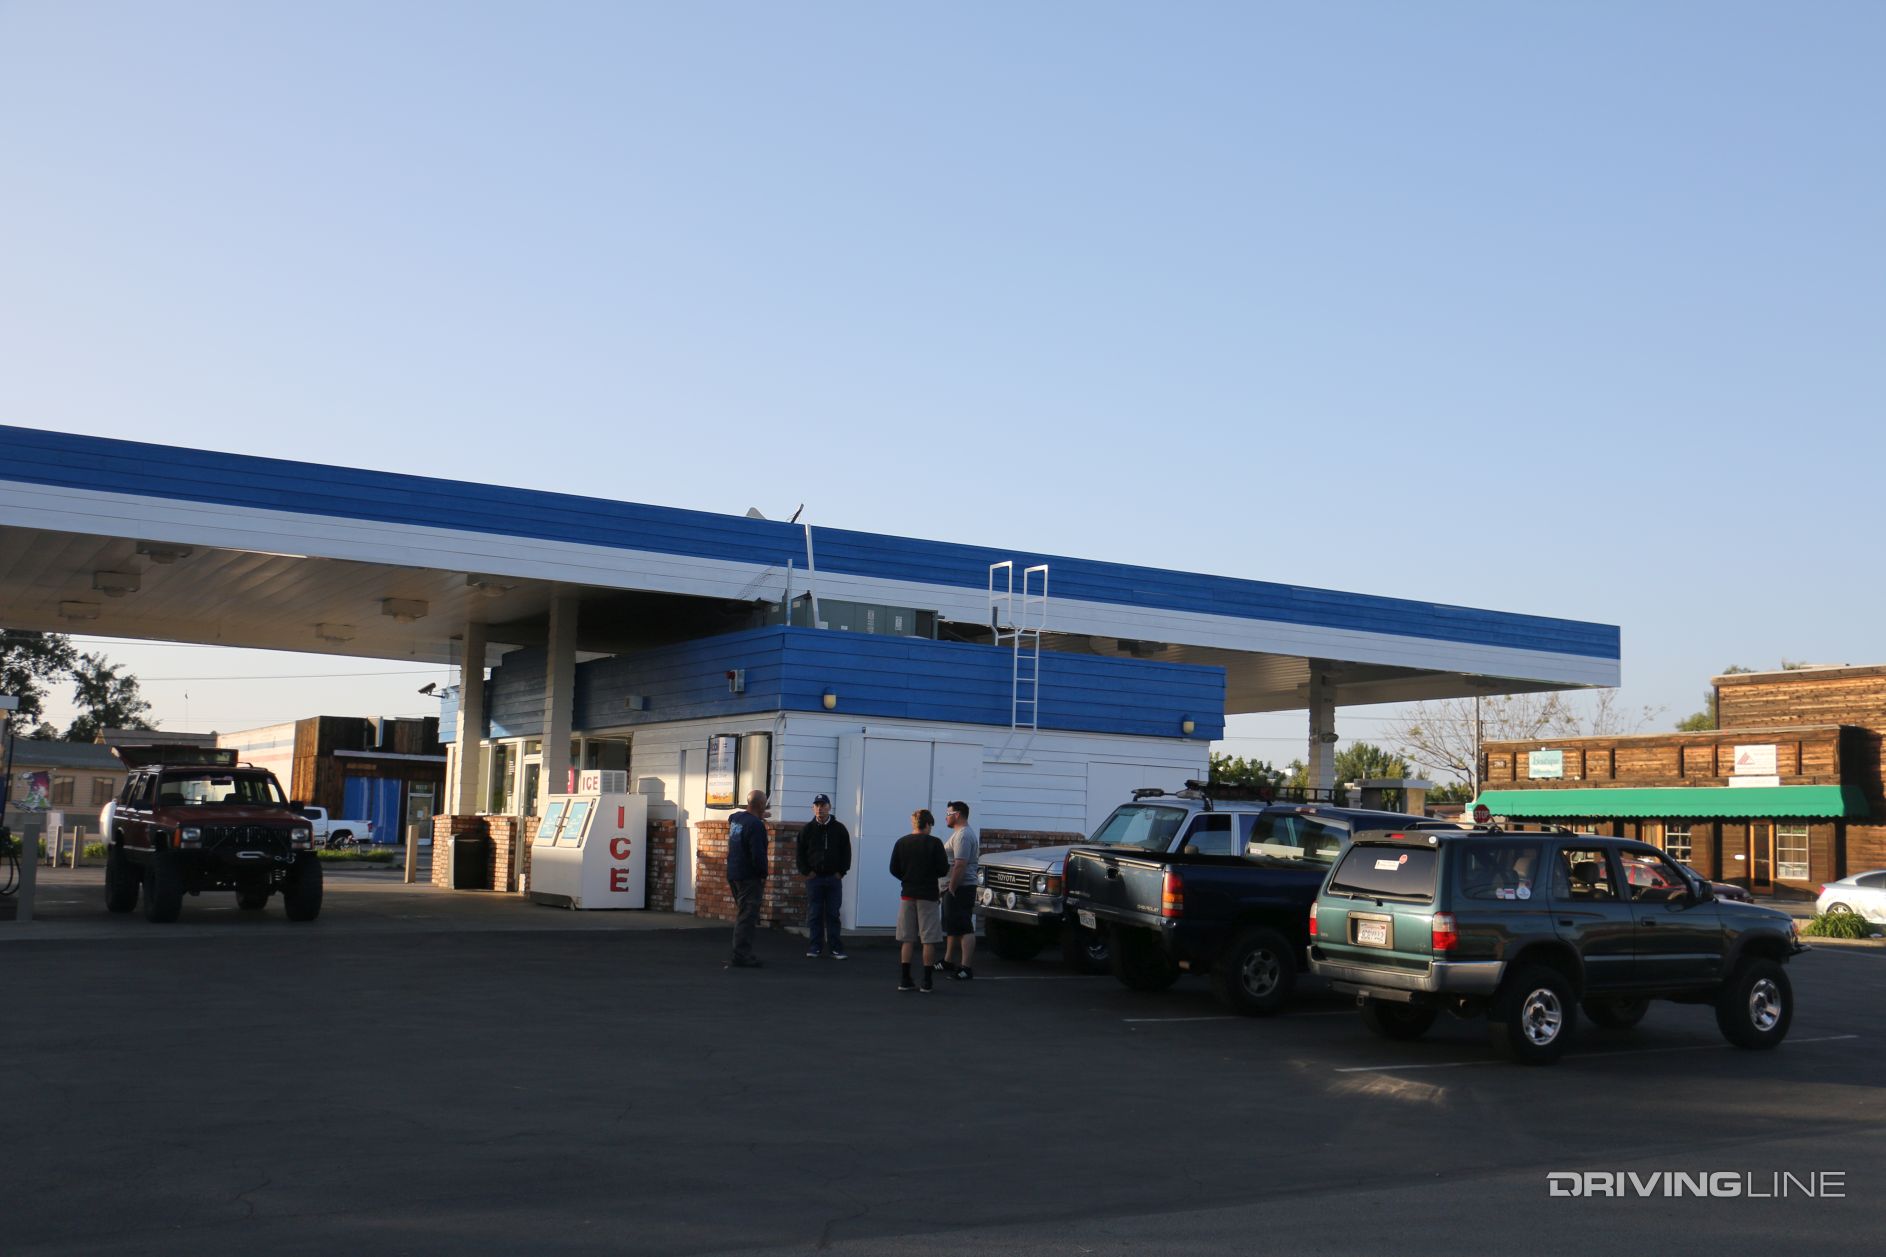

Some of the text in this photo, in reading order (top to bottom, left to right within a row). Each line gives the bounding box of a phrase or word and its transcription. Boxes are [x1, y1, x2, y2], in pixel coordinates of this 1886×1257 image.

[582, 776, 599, 791] ICE
[1475, 810, 1489, 819] STOP
[609, 805, 632, 892] ICE
[997, 873, 1016, 883] TOYOTA
